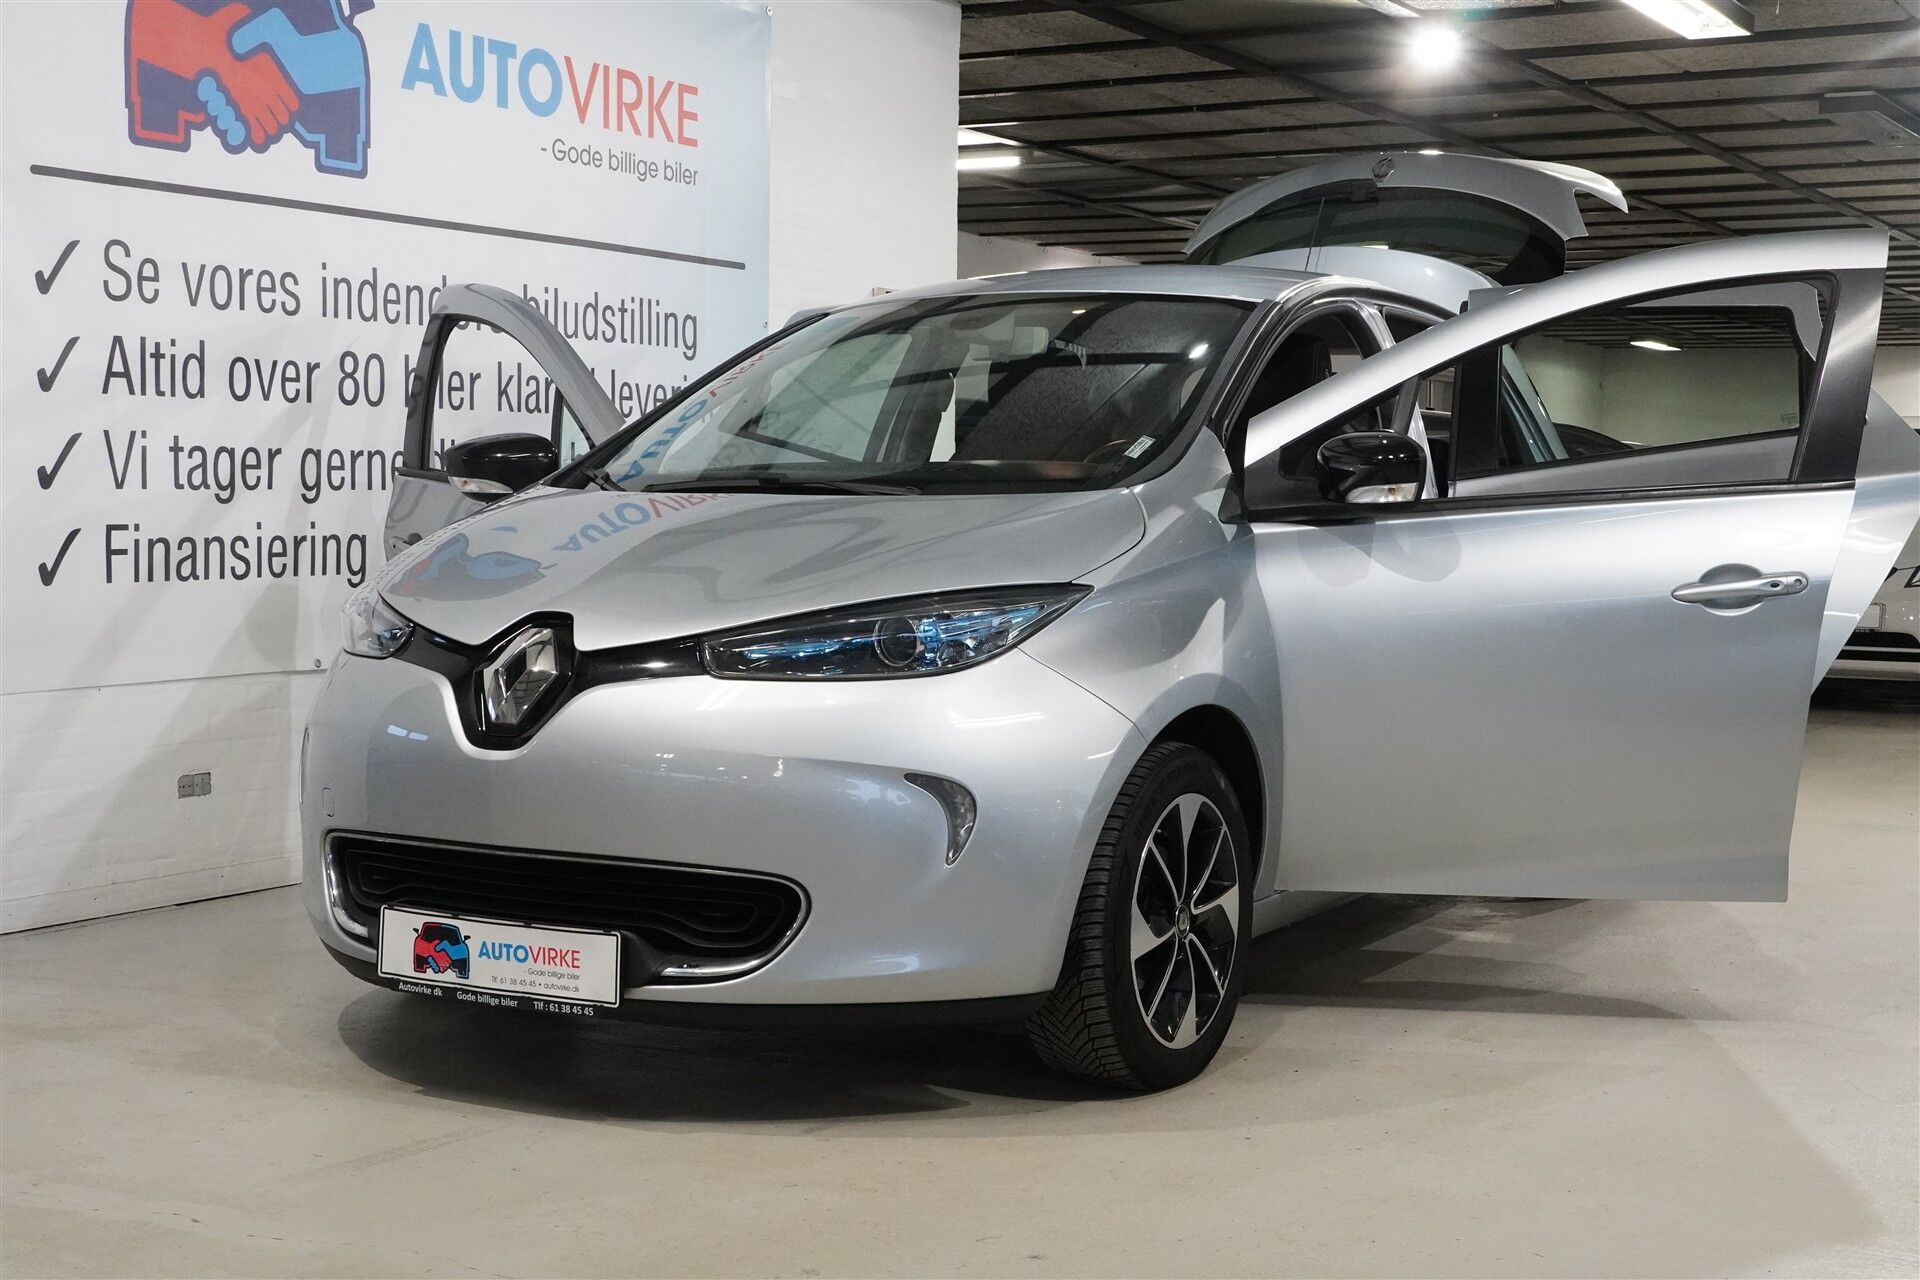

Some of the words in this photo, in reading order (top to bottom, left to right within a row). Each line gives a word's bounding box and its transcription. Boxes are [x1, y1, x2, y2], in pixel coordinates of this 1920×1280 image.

[402, 23, 698, 148] AUTOVIRKE
[552, 138, 603, 169] Gode
[608, 148, 659, 182] billige
[664, 159, 698, 187] biler
[103, 238, 160, 304] Se
[181, 262, 301, 317] vores
[101, 335, 206, 400] Altid
[228, 356, 320, 404] over
[338, 350, 385, 407] 80
[404, 353, 482, 411] bler
[103, 429, 148, 491] Vi
[168, 434, 283, 504] tager
[105, 521, 368, 588] Finansiering
[478, 941, 581, 970] AUTOVIRKE
[499, 977, 507, 985] 61
[509, 978, 517, 986] 38
[518, 979, 527, 987] 45
[527, 967, 546, 977] Gode
[547, 969, 566, 981] billige
[567, 973, 580, 981] biler
[456, 991, 476, 1003] Gode
[477, 993, 500, 1006] billige
[501, 996, 518, 1008] biler
[549, 1003, 559, 1012] 61
[561, 1004, 571, 1014] 38
[572, 1005, 582, 1015] 45
[583, 1007, 594, 1017] 45
